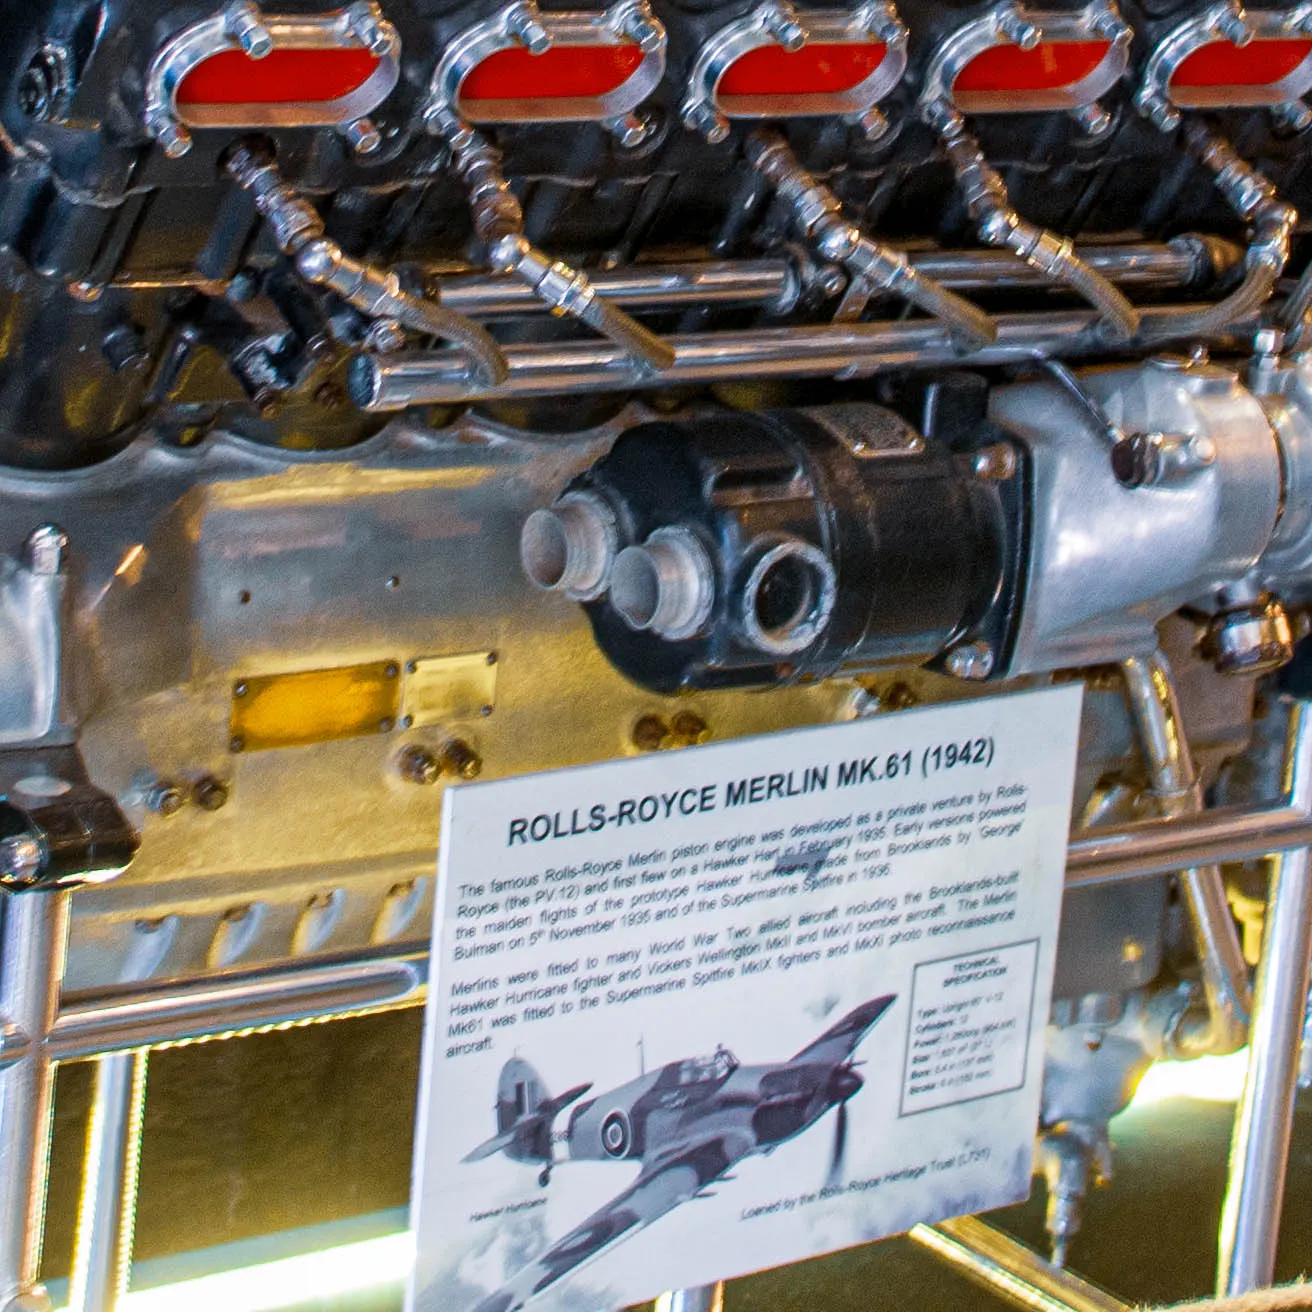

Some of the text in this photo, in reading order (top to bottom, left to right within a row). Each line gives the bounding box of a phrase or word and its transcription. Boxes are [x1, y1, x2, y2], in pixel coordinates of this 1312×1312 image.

[508, 735, 996, 847] ROLLS-ROYCE MERLIN MK.61 (1942)
[456, 900, 498, 918] Royce
[504, 893, 530, 912] (the
[613, 872, 636, 889] first
[703, 853, 750, 872] Hawker
[893, 821, 923, 836] Early
[928, 813, 974, 830] versions
[978, 801, 1026, 824] powered
[483, 915, 531, 934] maiden
[539, 905, 578, 924] flights
[630, 885, 689, 909] prototype
[696, 874, 743, 892] Hawker
[749, 862, 809, 882] Hurricane
[854, 849, 880, 863] from
[887, 834, 951, 856] Brooklands
[490, 874, 539, 892] famous
[544, 859, 622, 882] Rolls-Royce
[628, 849, 666, 867] Merlin
[671, 843, 708, 862] piston
[714, 834, 756, 852] engine
[790, 814, 851, 837] developed
[886, 802, 927, 822] private
[931, 795, 973, 811] venture
[449, 996, 500, 1016] Hawker
[505, 982, 568, 1005] Hurricane
[573, 973, 613, 992] fighter
[647, 957, 692, 975] Vickers
[697, 943, 760, 965] Wellington
[857, 914, 901, 932] bomber
[982, 890, 1017, 907] Merlin
[451, 977, 499, 996] Merlins
[507, 969, 539, 985] were
[547, 958, 579, 977] fitted
[606, 949, 641, 965] many
[649, 937, 684, 956] World
[758, 916, 790, 934] allied
[798, 906, 838, 926] aircraft
[845, 897, 897, 916] including
[549, 918, 615, 941] November
[619, 909, 651, 927] 1935
[721, 883, 798, 907] Supermarine
[803, 874, 843, 893] Spitfire
[523, 1002, 555, 1021] fitted
[605, 978, 685, 1004] Supermarine
[691, 968, 735, 987] Spitfire
[776, 950, 821, 970] fighters
[888, 928, 922, 948] photo
